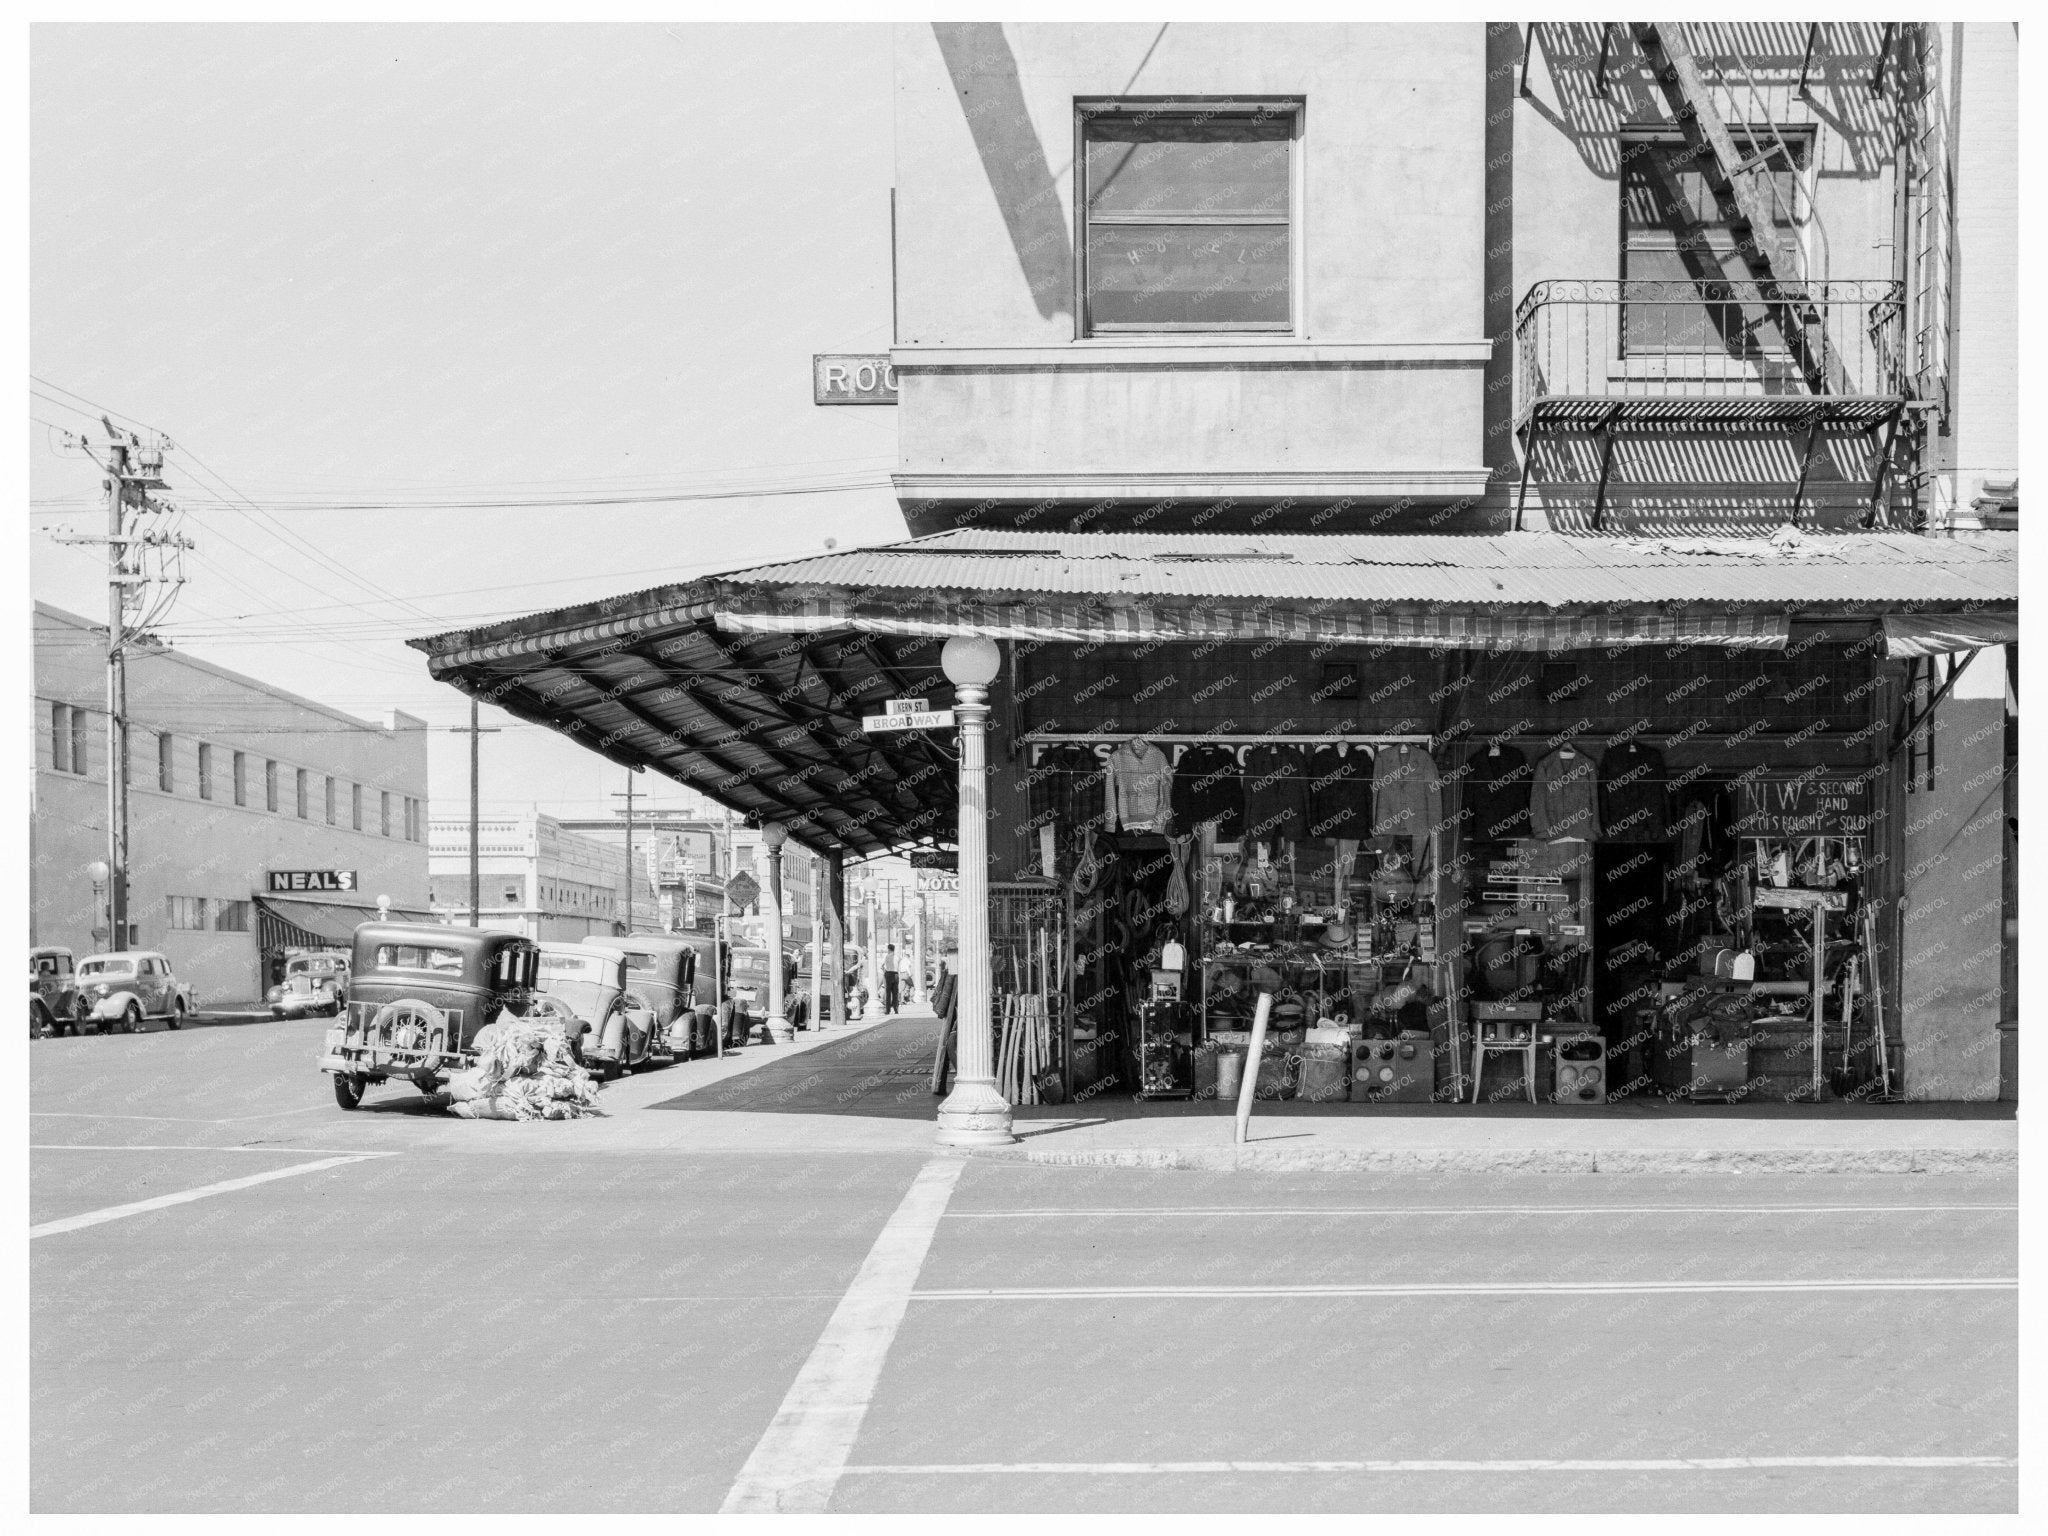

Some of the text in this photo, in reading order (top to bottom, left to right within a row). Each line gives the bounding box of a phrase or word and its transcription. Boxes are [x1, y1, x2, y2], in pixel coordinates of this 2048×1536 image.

[897, 701, 913, 712] KERN
[873, 714, 941, 729] BROADWAY
[1816, 797, 1848, 811] HAND
[274, 871, 352, 890] NEAL'S
